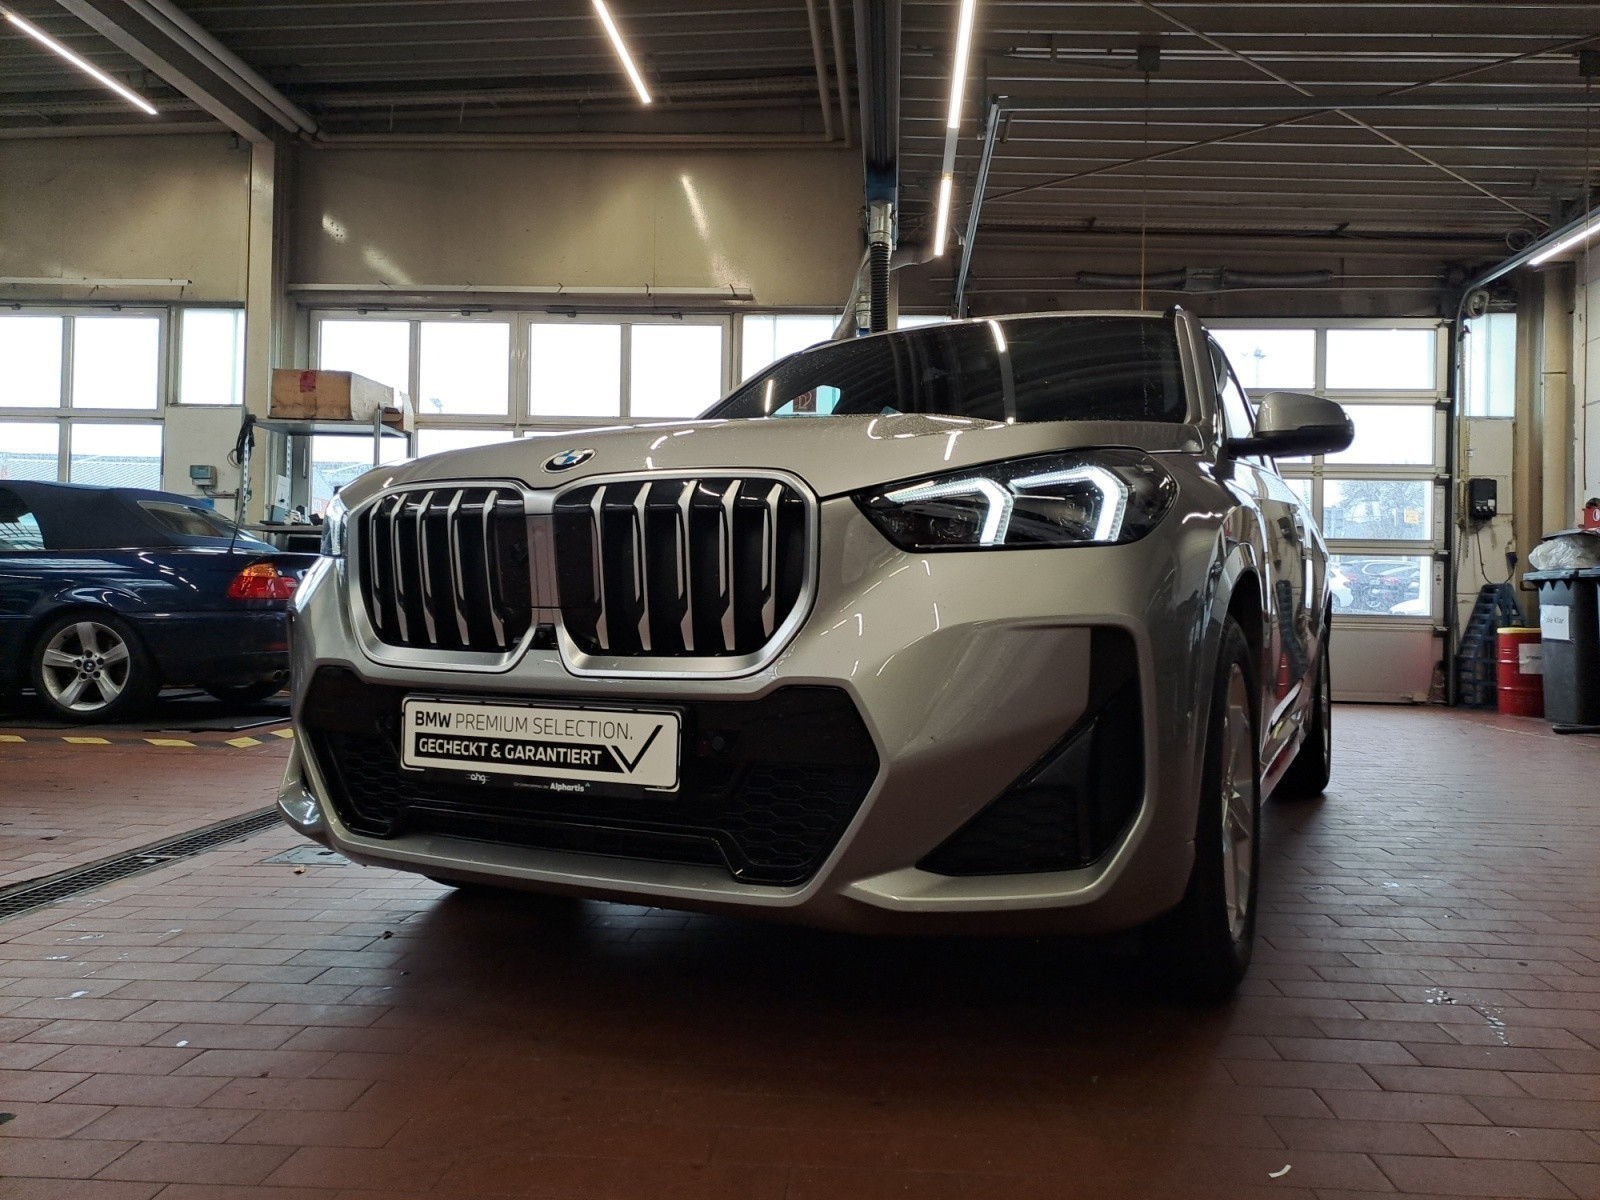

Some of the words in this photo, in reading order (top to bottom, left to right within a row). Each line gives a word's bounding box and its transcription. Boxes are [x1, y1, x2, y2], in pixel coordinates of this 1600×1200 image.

[415, 710, 452, 728] BMW
[455, 713, 528, 733] PREMIUM
[533, 717, 634, 741] SELECTION.
[419, 738, 489, 757] GECHECKT
[490, 743, 502, 758] &
[504, 745, 603, 765] GARANTIERT
[549, 782, 585, 792] Alphartis
